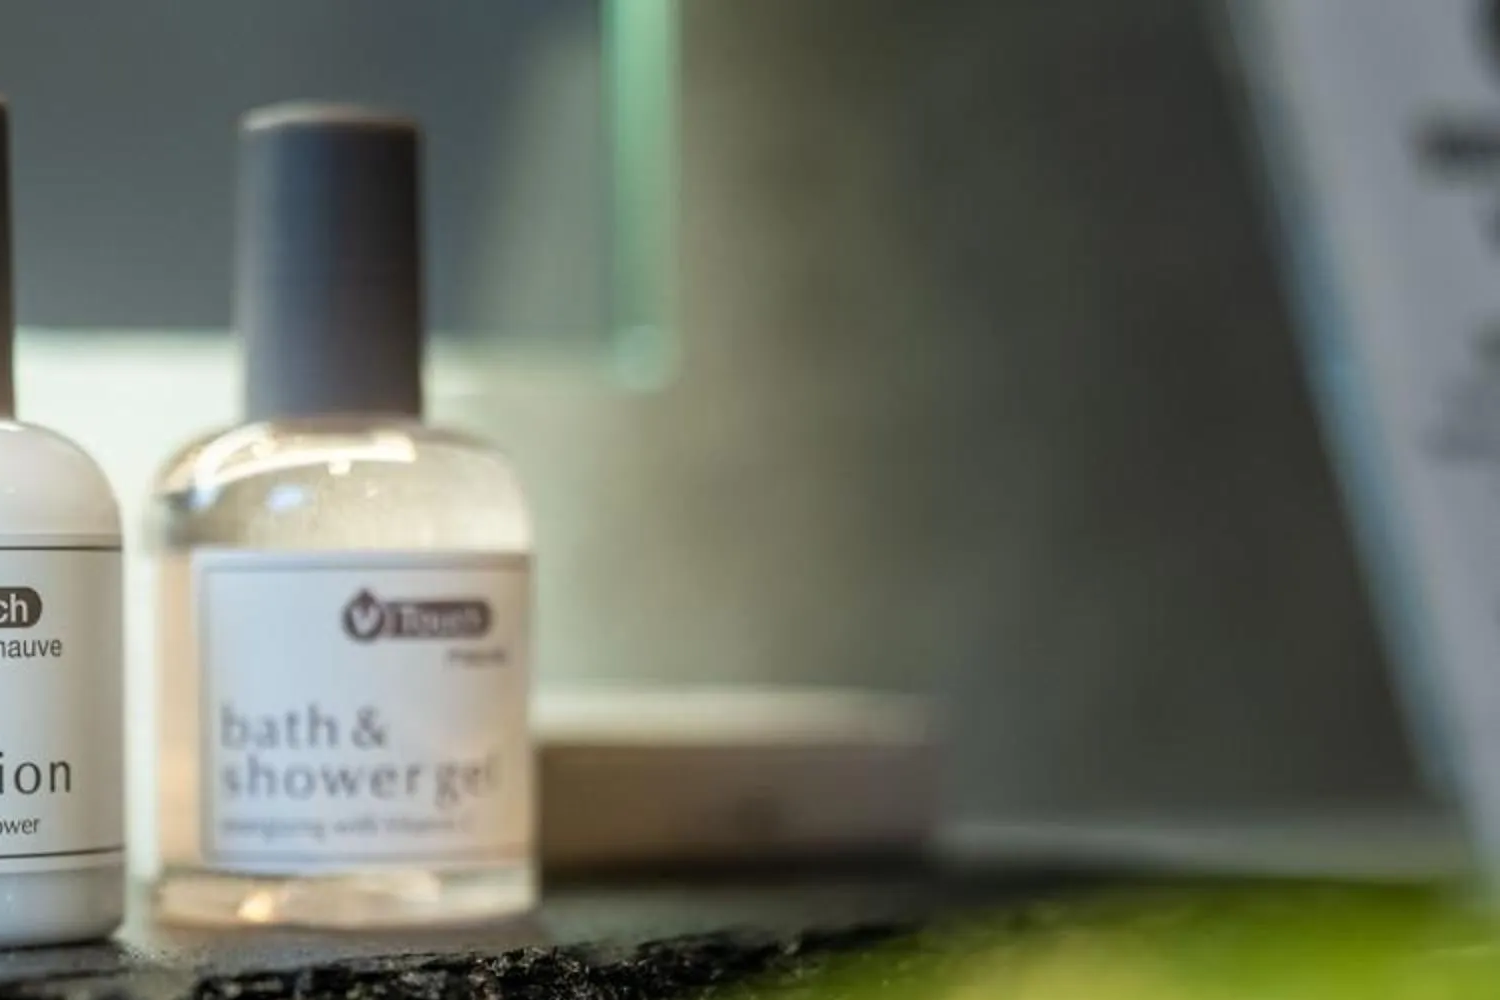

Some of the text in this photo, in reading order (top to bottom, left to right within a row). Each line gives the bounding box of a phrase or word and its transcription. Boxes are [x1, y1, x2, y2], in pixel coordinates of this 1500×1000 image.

[220, 703, 387, 749] bath &
[221, 752, 422, 801] shower
